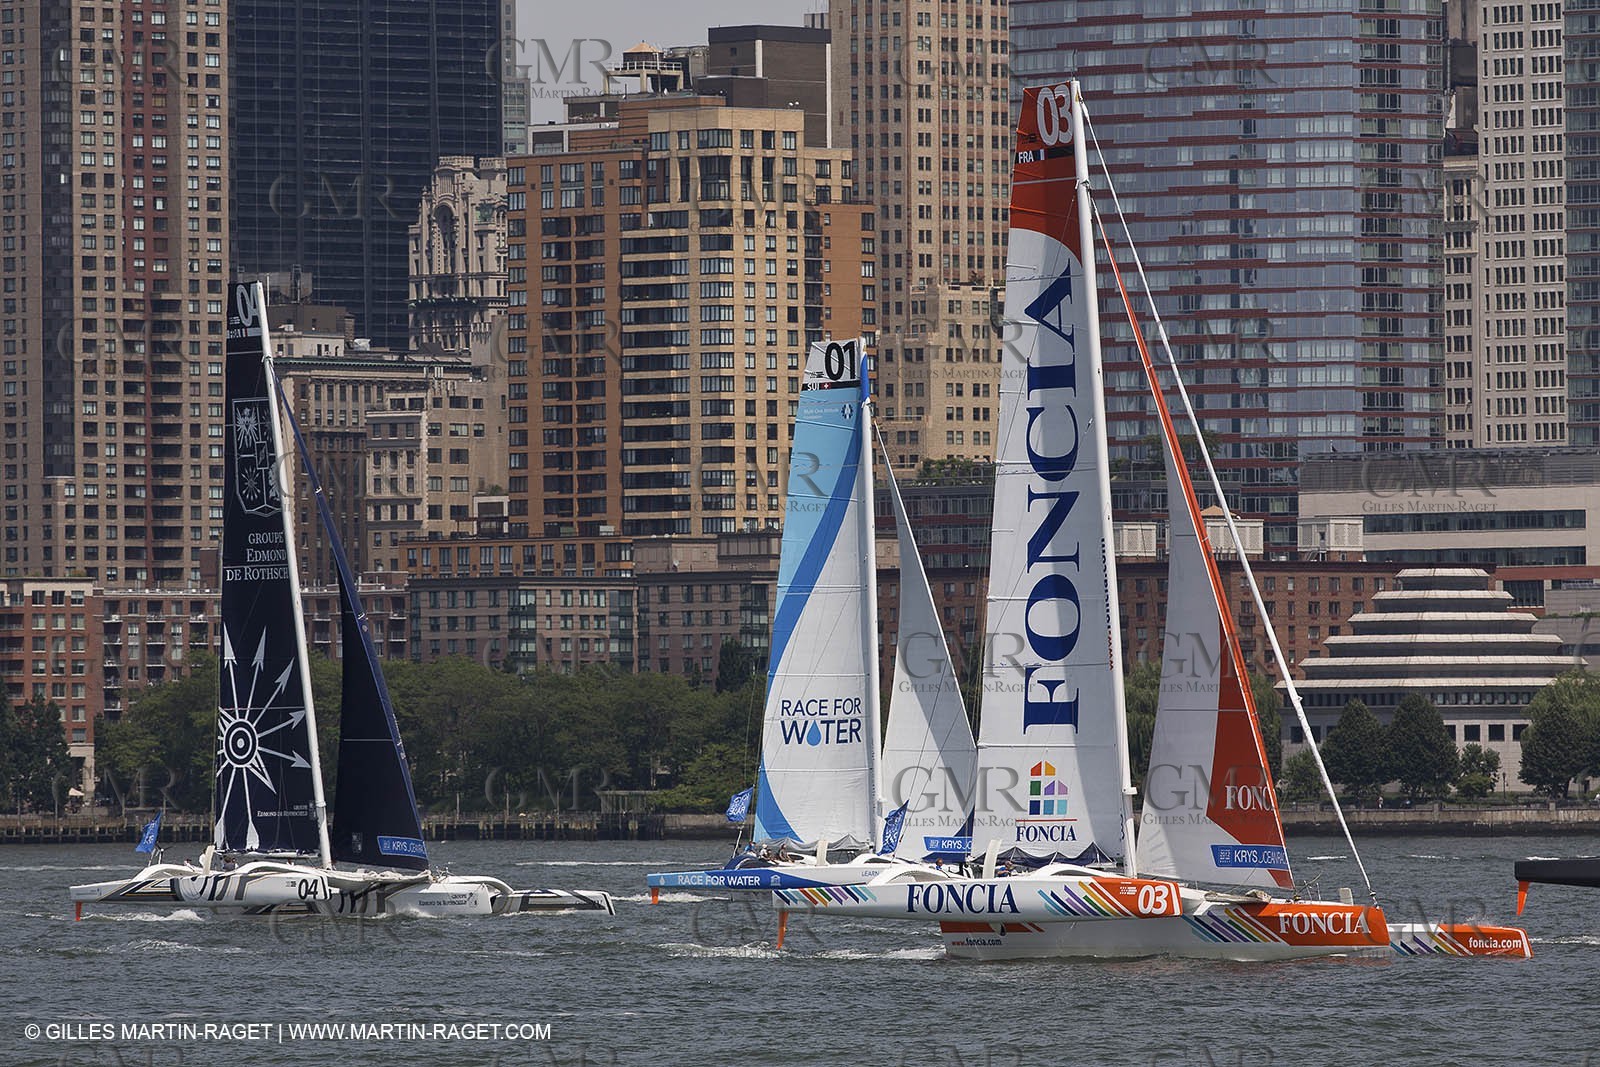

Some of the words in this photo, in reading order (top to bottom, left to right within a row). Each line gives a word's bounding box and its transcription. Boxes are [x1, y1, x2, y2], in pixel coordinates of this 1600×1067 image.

[1037, 84, 1073, 146] 03
[1018, 151, 1034, 163] FRA
[825, 341, 856, 381] 01
[807, 382, 820, 391] SUI
[1023, 258, 1081, 736] FONCIA
[248, 531, 284, 544] GROUPE
[246, 548, 287, 562] EDMOND
[226, 569, 242, 581] DE
[781, 699, 828, 716] RACE
[834, 698, 861, 715] FOR
[1016, 825, 1076, 841] FONCIA
[942, 839, 962, 849] KRYS
[1234, 850, 1258, 863] KRYS
[678, 875, 703, 885] RACE
[705, 876, 725, 886] FOR
[727, 876, 761, 886] WATER
[298, 878, 319, 900] 04
[907, 883, 1021, 914] FONCIA
[1138, 884, 1169, 915] 03
[1278, 912, 1371, 934] FONCIA
[952, 938, 1002, 946] www.foncia.com
[1468, 937, 1522, 948] foncia.com
